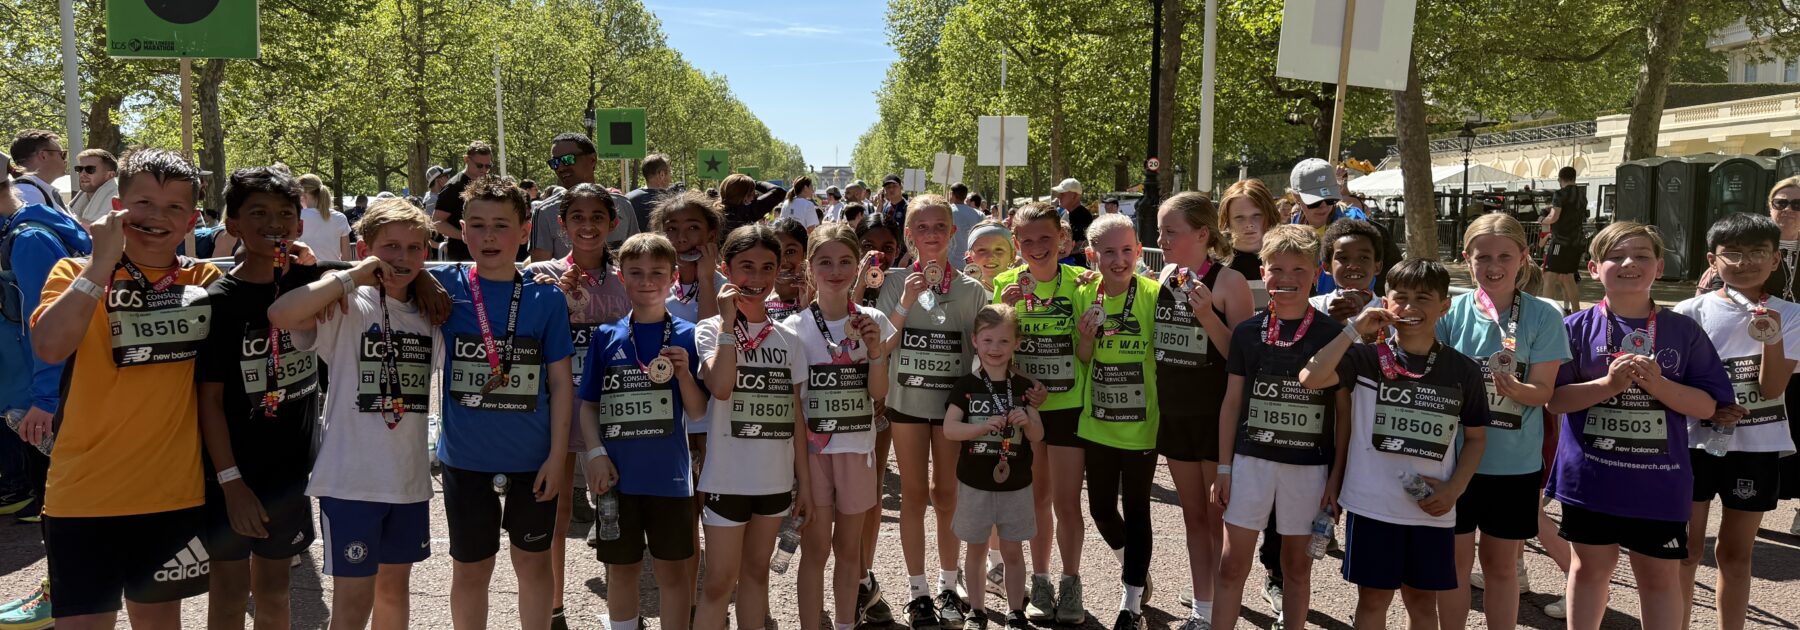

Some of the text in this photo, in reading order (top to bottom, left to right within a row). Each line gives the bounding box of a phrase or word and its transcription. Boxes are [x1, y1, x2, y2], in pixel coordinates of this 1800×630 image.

[111, 40, 126, 50] tcs
[108, 289, 143, 308] tcs
[476, 303, 490, 334] FINISHER
[508, 301, 519, 332] FINISHER
[1155, 303, 1172, 321] tcs
[1172, 316, 1191, 324] SERVICES
[112, 326, 120, 334] 31
[131, 319, 189, 338] 18516
[242, 335, 270, 357] tc
[903, 331, 928, 348] tcs
[1020, 339, 1036, 353] cs
[1119, 339, 1150, 350] WAY
[1160, 331, 1189, 348] 18501
[455, 337, 487, 359] tcs
[153, 353, 170, 361] new
[402, 352, 426, 360] SERVICES
[762, 347, 788, 366] NOT
[1173, 357, 1197, 366] balance
[277, 355, 313, 381] 8523
[913, 358, 951, 372] 18522
[1025, 363, 1060, 375] 18519
[247, 373, 256, 381] 31
[401, 373, 425, 388] 524
[468, 372, 521, 388] 189
[601, 374, 620, 391] cs
[735, 370, 765, 390] tcs
[810, 367, 837, 387] tcs
[840, 379, 864, 387] SERVICES
[623, 381, 652, 389] SERVICES
[1253, 378, 1278, 398] tcs
[1281, 386, 1324, 396] CONSULTANCY
[1416, 386, 1437, 395] TATA
[287, 392, 301, 400] new
[1097, 391, 1128, 404] 18518
[1281, 393, 1310, 401] SERVICES
[1379, 382, 1412, 404] tcs
[1415, 393, 1460, 406] CONSULTANCY
[498, 402, 528, 410] balance
[609, 401, 652, 417] 18515
[749, 403, 789, 417] 18507
[824, 398, 864, 412] 18514
[969, 400, 990, 413] tcs
[1414, 400, 1444, 410] SERVICES
[1263, 410, 1307, 426] 18510
[1490, 419, 1514, 428] alance
[1600, 417, 1652, 433] 18503
[1752, 415, 1778, 423] balance
[636, 428, 664, 436] balance
[1391, 416, 1443, 437] 18506
[1288, 439, 1315, 447] balance
[1403, 446, 1419, 454] new
[1631, 446, 1659, 454] balance
[1584, 452, 1681, 471] www.sepsisresearch.org.uk
[153, 561, 210, 582] adida
